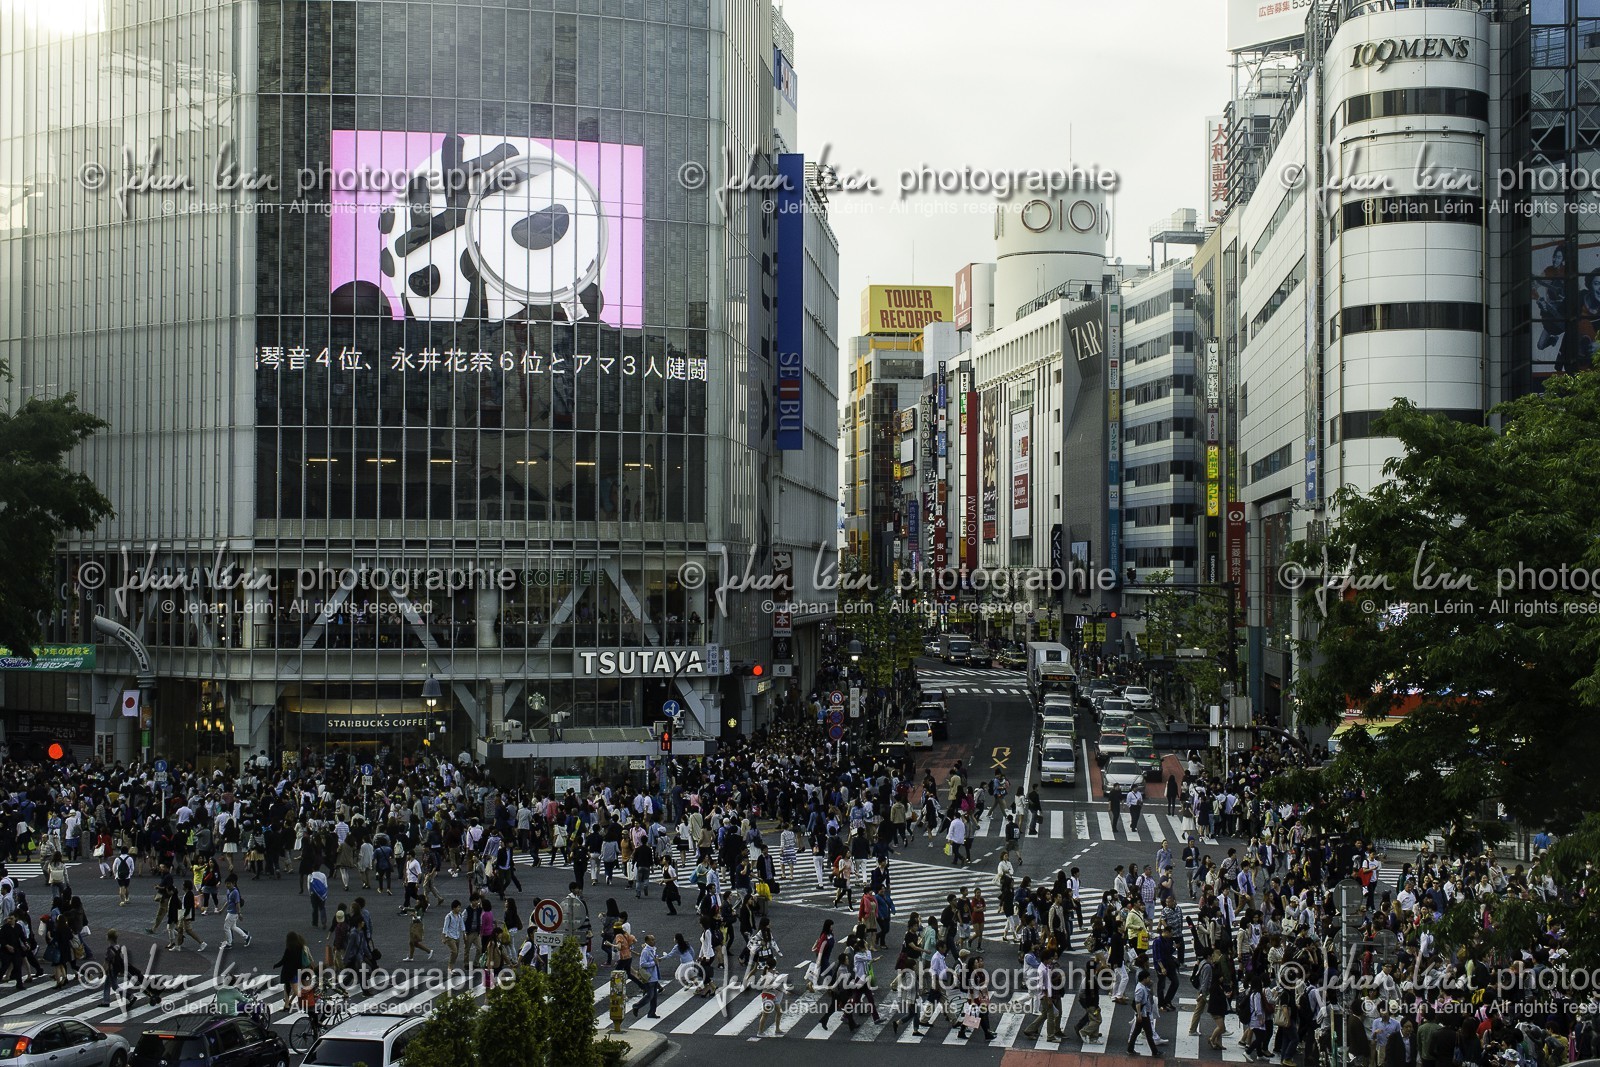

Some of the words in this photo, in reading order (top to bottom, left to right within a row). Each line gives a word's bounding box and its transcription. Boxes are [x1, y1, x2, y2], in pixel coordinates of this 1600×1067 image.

[884, 289, 933, 308] TOWER
[880, 309, 943, 329] RECORDS
[255, 346, 707, 382] 琴音4位、永井花奈6位とアマ3人健闘
[780, 352, 800, 432] SEIBU
[921, 394, 930, 457] KARAOKE
[1053, 531, 1062, 568] ZARA
[520, 569, 605, 586] COFFEE
[775, 613, 790, 627] 本
[580, 650, 704, 674] TSUTAYA
[393, 719, 427, 727] COFFEE
[536, 935, 561, 945] ここから
